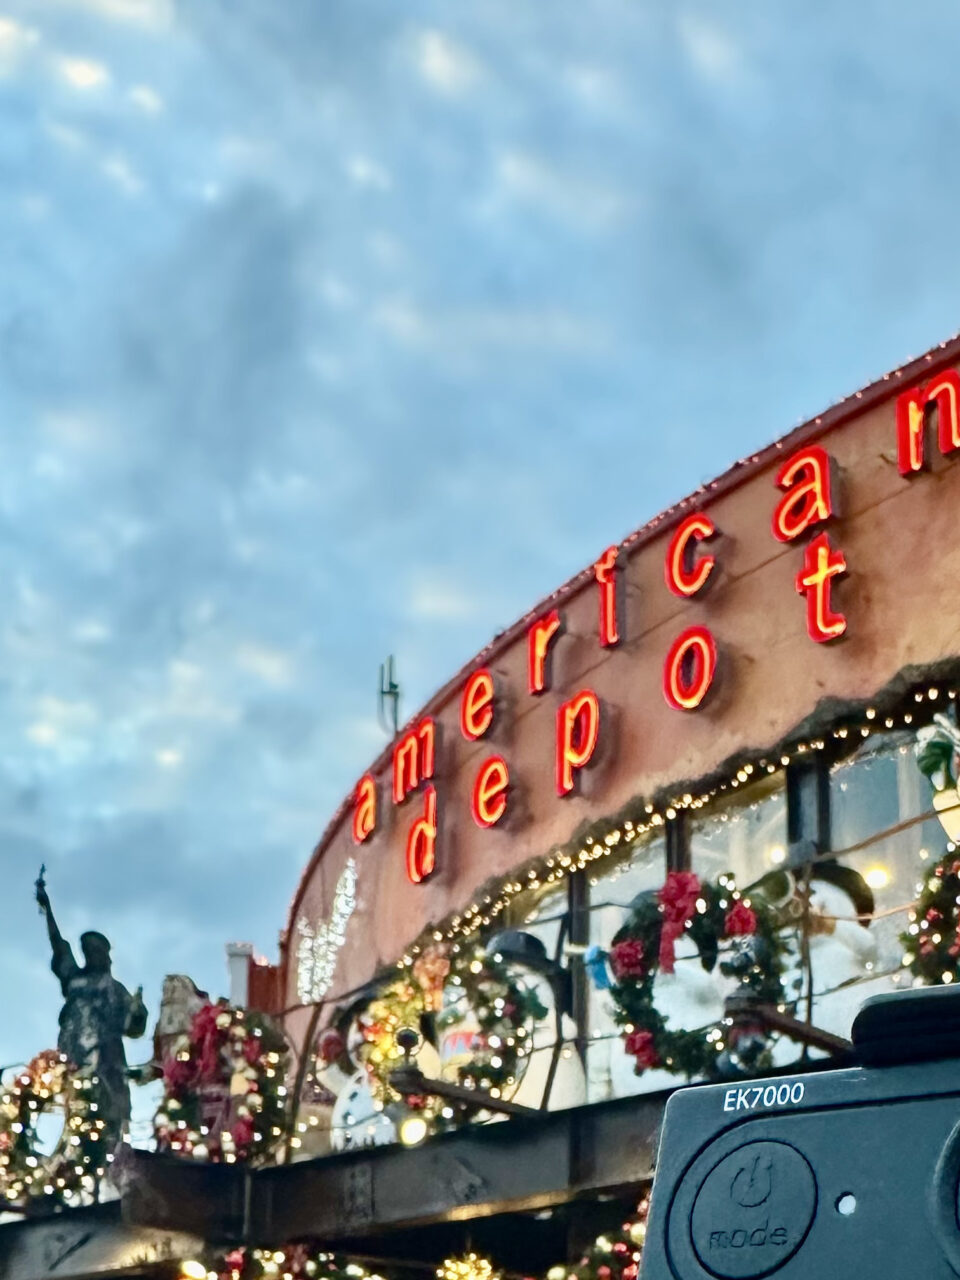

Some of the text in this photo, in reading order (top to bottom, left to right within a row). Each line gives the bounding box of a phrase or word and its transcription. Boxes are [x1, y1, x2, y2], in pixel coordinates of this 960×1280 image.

[406, 532, 848, 884] depot
[723, 1082, 805, 1112] EK7000
[709, 1217, 789, 1250] mode
